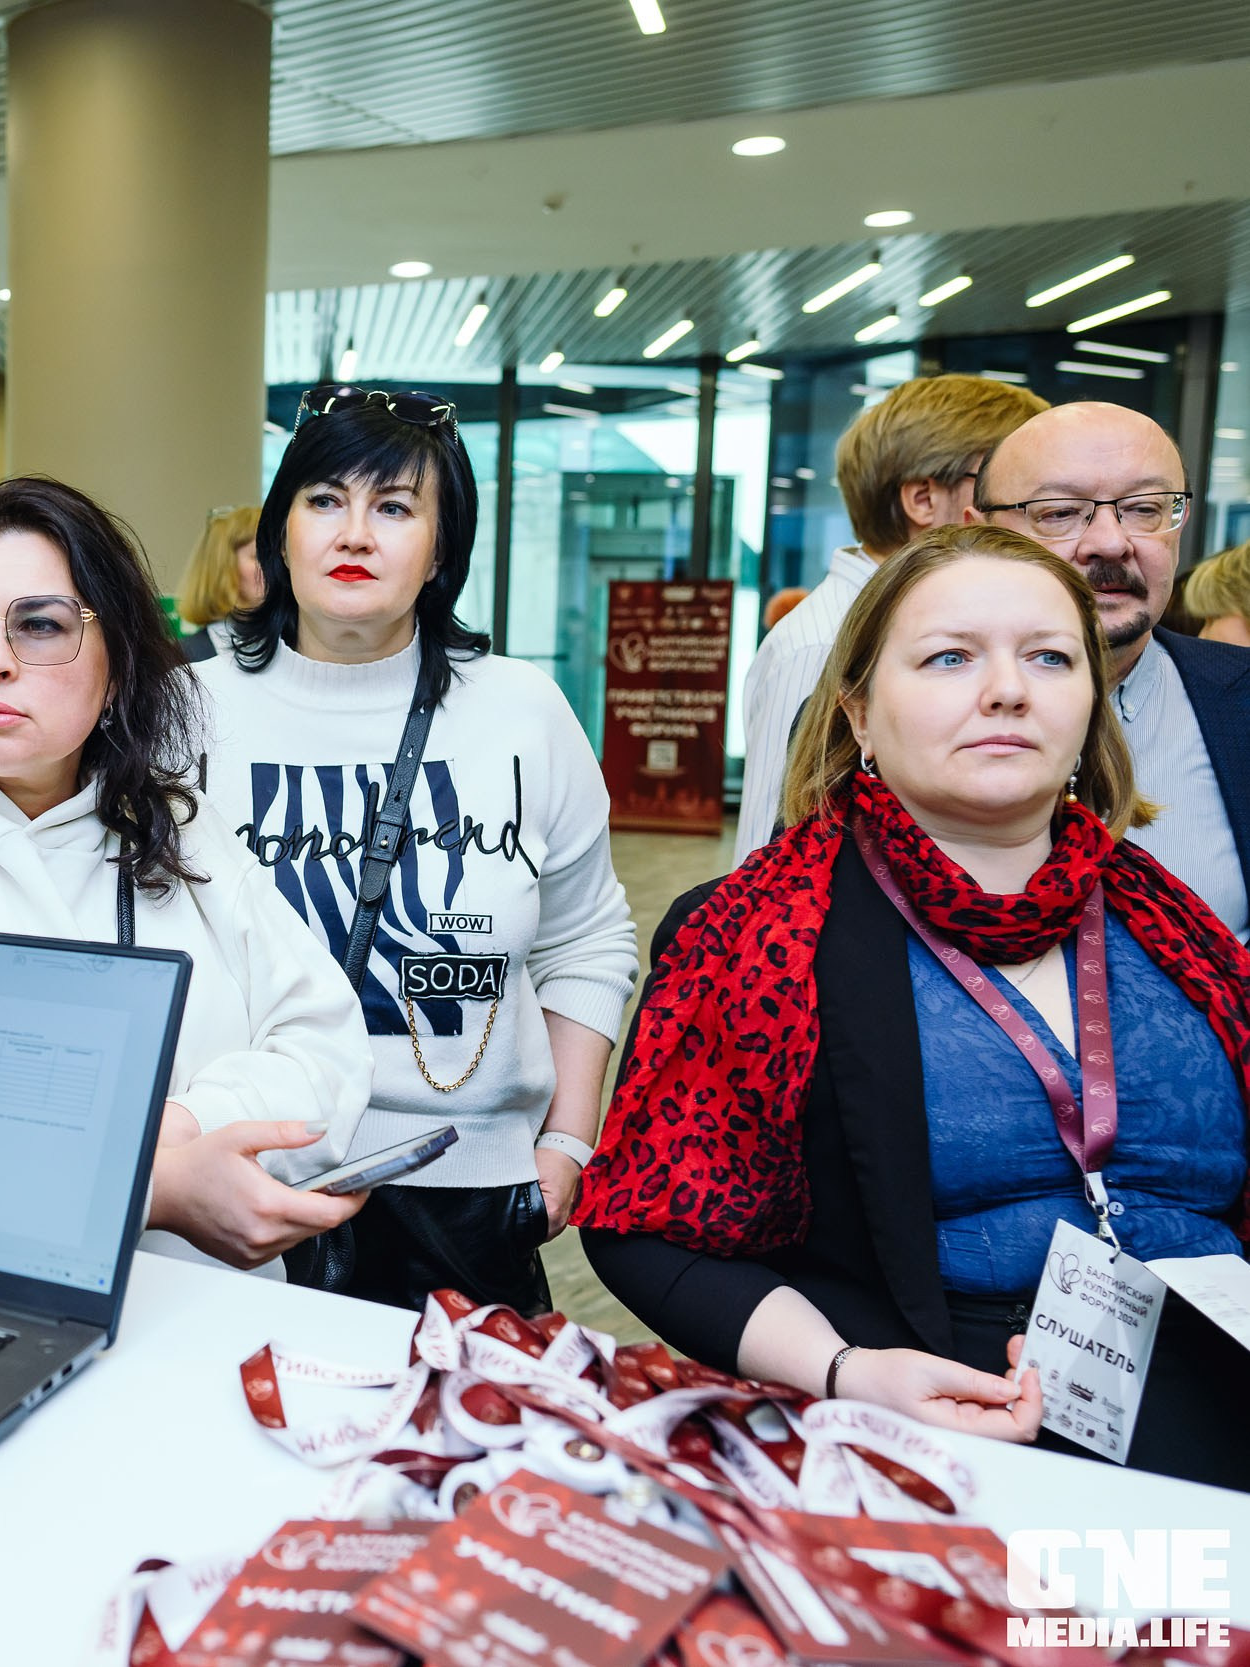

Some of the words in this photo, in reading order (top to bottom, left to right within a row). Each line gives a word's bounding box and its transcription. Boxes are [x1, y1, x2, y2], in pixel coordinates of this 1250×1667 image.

[438, 916, 484, 930] WOW
[406, 962, 499, 994] SODA
[1083, 1278, 1148, 1318] КУЛЬТУРНЫЙ
[1086, 1265, 1153, 1307] БАЛТИЙСКИЙ
[1079, 1292, 1116, 1317] ФОРУМ
[1117, 1310, 1139, 1329] 2024
[1035, 1313, 1136, 1374] СЛУШАТЕЛЬ
